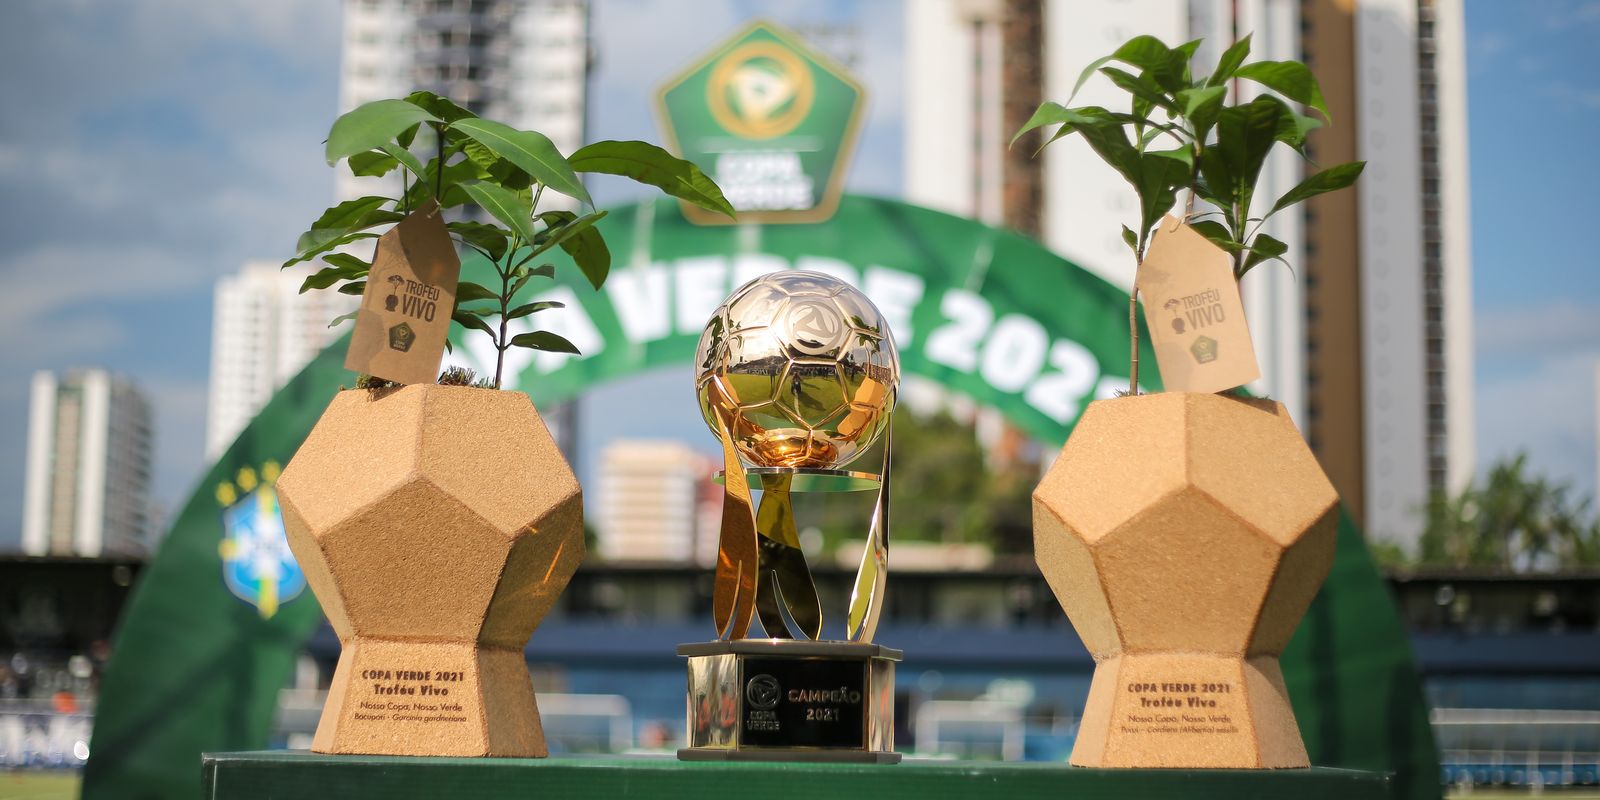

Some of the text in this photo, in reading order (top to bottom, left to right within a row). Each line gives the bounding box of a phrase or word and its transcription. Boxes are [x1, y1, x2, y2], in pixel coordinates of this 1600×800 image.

[402, 294, 436, 322] VIVO
[1185, 303, 1226, 330] VIVO
[362, 670, 464, 681] COPA VERDE 2021
[374, 684, 448, 696] Troféu Vivo
[1128, 683, 1230, 694] COPA VERDE 2021
[788, 686, 861, 703] CAMPEÃO
[387, 702, 410, 712] Copa,
[440, 703, 462, 712] Verde
[1141, 697, 1217, 708] Troféu Vivo
[750, 710, 776, 720] COPA
[806, 708, 839, 721] 2021
[1208, 715, 1231, 723] Verde
